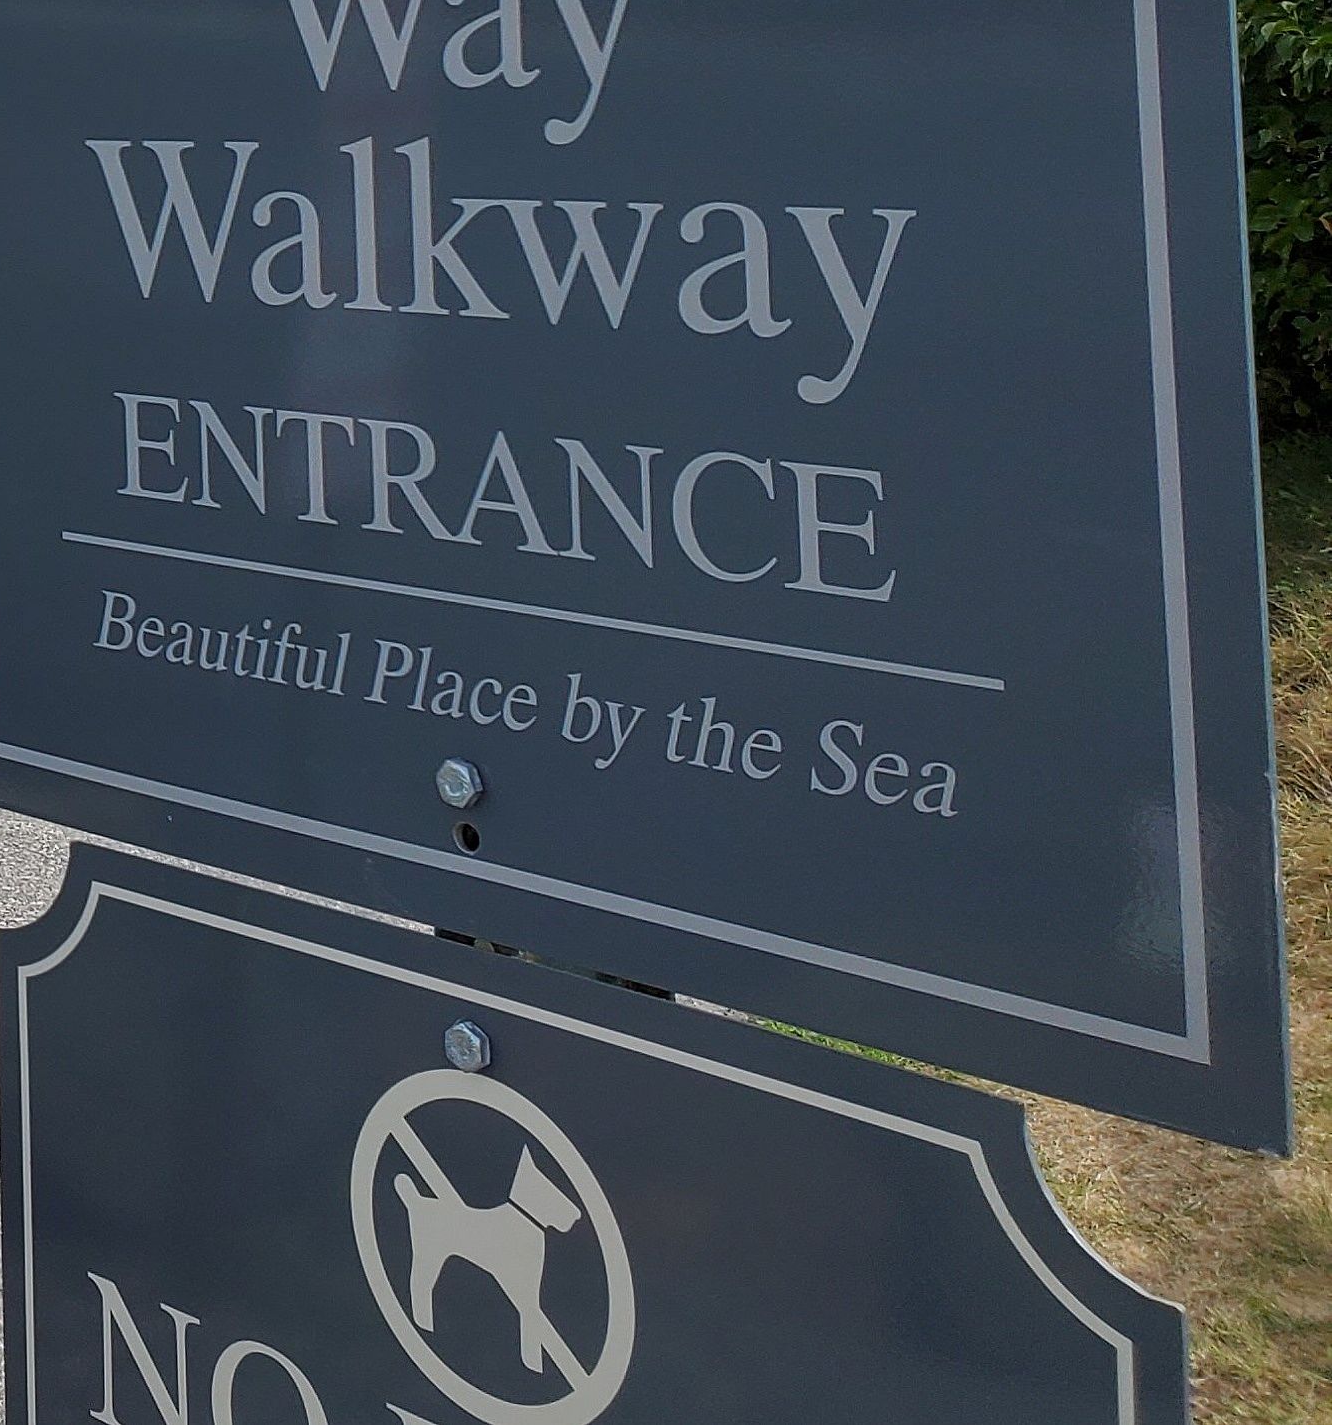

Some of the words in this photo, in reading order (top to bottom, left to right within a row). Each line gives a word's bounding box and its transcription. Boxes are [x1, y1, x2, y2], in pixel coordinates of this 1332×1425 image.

[84, 136, 917, 404] Walkway
[113, 392, 897, 603] ENTRANCE
[92, 589, 352, 696] Beautiful
[362, 639, 539, 731] Place
[561, 672, 647, 770] by
[666, 696, 783, 780] the
[810, 720, 960, 817] Sea
